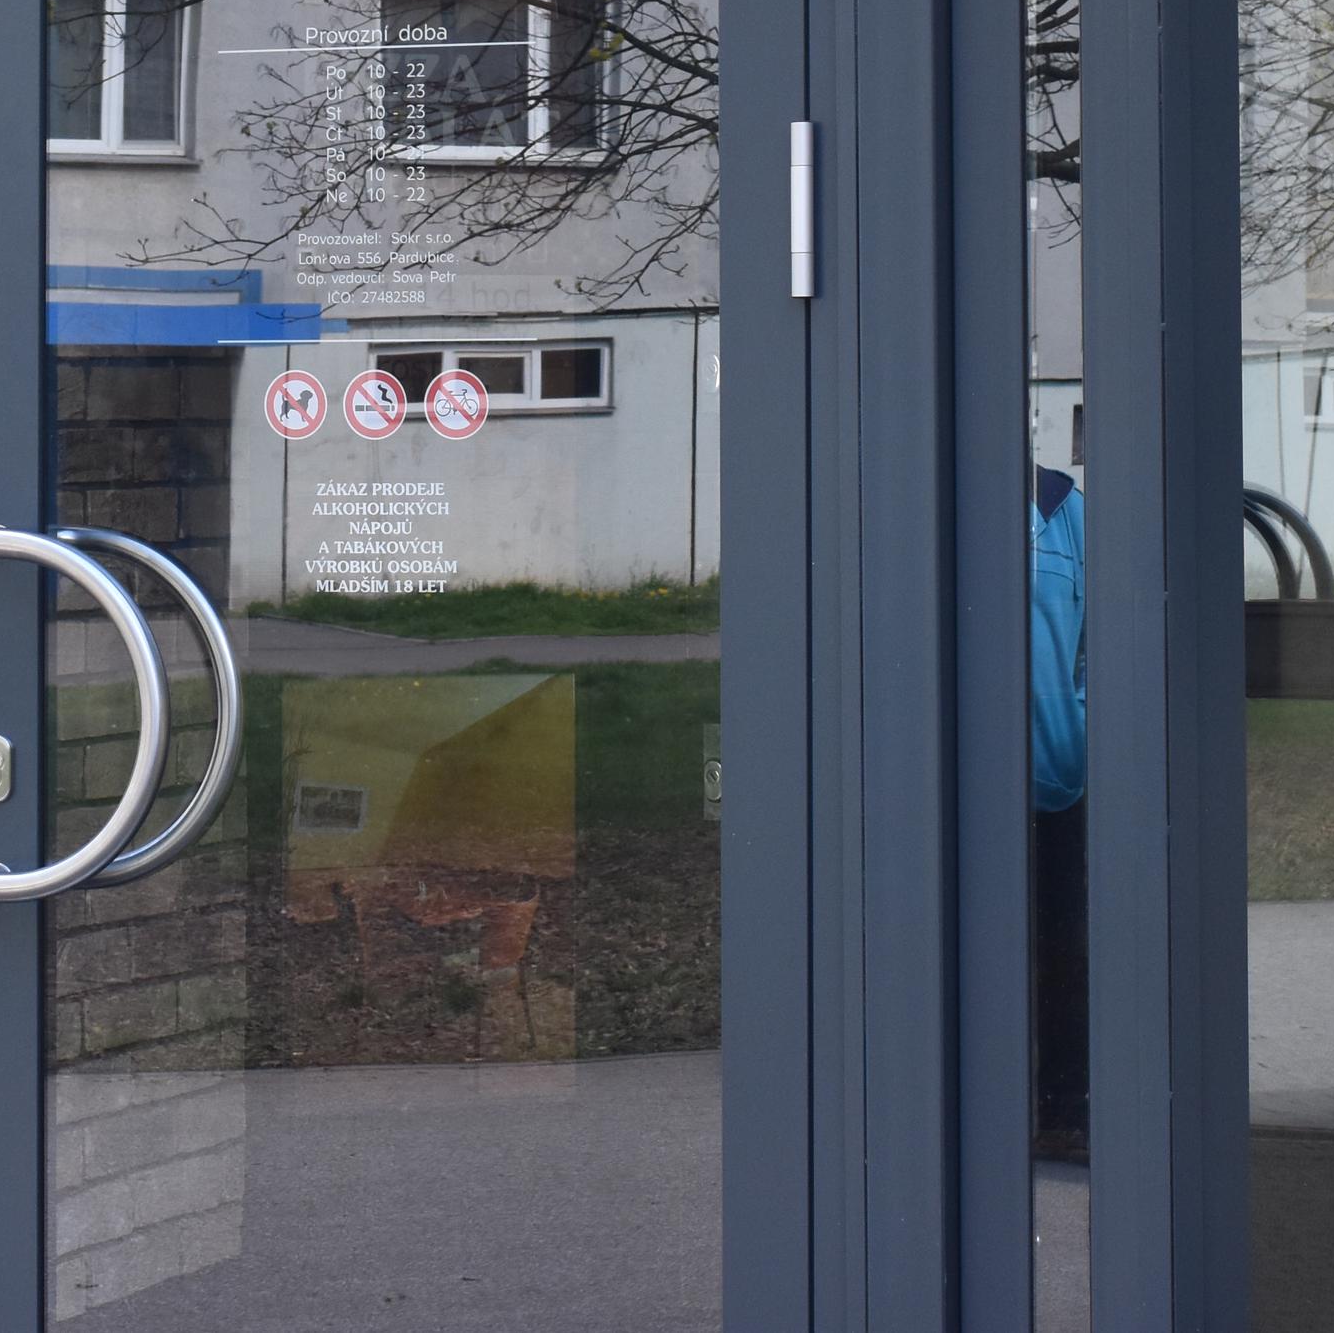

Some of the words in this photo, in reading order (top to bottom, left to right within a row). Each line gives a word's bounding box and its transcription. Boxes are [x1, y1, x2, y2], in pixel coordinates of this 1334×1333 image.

[305, 25, 388, 44] Provozní
[398, 23, 448, 42] doba
[326, 66, 346, 80] Po
[367, 65, 386, 79] 10
[406, 63, 425, 78] 22
[326, 82, 343, 100] Út
[367, 85, 386, 99] 10
[406, 84, 425, 99] 23
[326, 106, 343, 121] St
[367, 105, 386, 119] 10
[406, 104, 425, 119] 23
[367, 126, 386, 140] 10
[406, 125, 425, 140] 23
[326, 147, 346, 162] Pá
[367, 147, 386, 161] 10
[326, 168, 346, 183] So
[367, 167, 386, 181] 10
[406, 166, 425, 181] 23
[326, 189, 348, 203] Ne
[367, 188, 386, 202] 10
[406, 187, 425, 202] 22
[298, 233, 382, 245] Provozovatel:
[391, 232, 420, 244] Sokr
[426, 233, 454, 244] s.r.o.
[296, 273, 327, 286] Odp.
[392, 271, 423, 283] Sova
[430, 270, 456, 283] Petr
[361, 291, 425, 304] 27482588
[316, 479, 368, 496] ZÁKAZ
[371, 482, 445, 496] PRODEJE
[311, 498, 449, 516] ALKOHOLICKÝCH
[349, 518, 413, 535] NÁPOJŮ
[318, 541, 329, 554] A
[334, 537, 444, 554] TABÁKOVÝCH
[305, 557, 383, 574] VÝROBKŮ
[387, 557, 458, 574] OSOBÁM
[316, 576, 389, 593] MLADŠÍM
[395, 579, 414, 593] 18
[418, 579, 447, 593] LET
